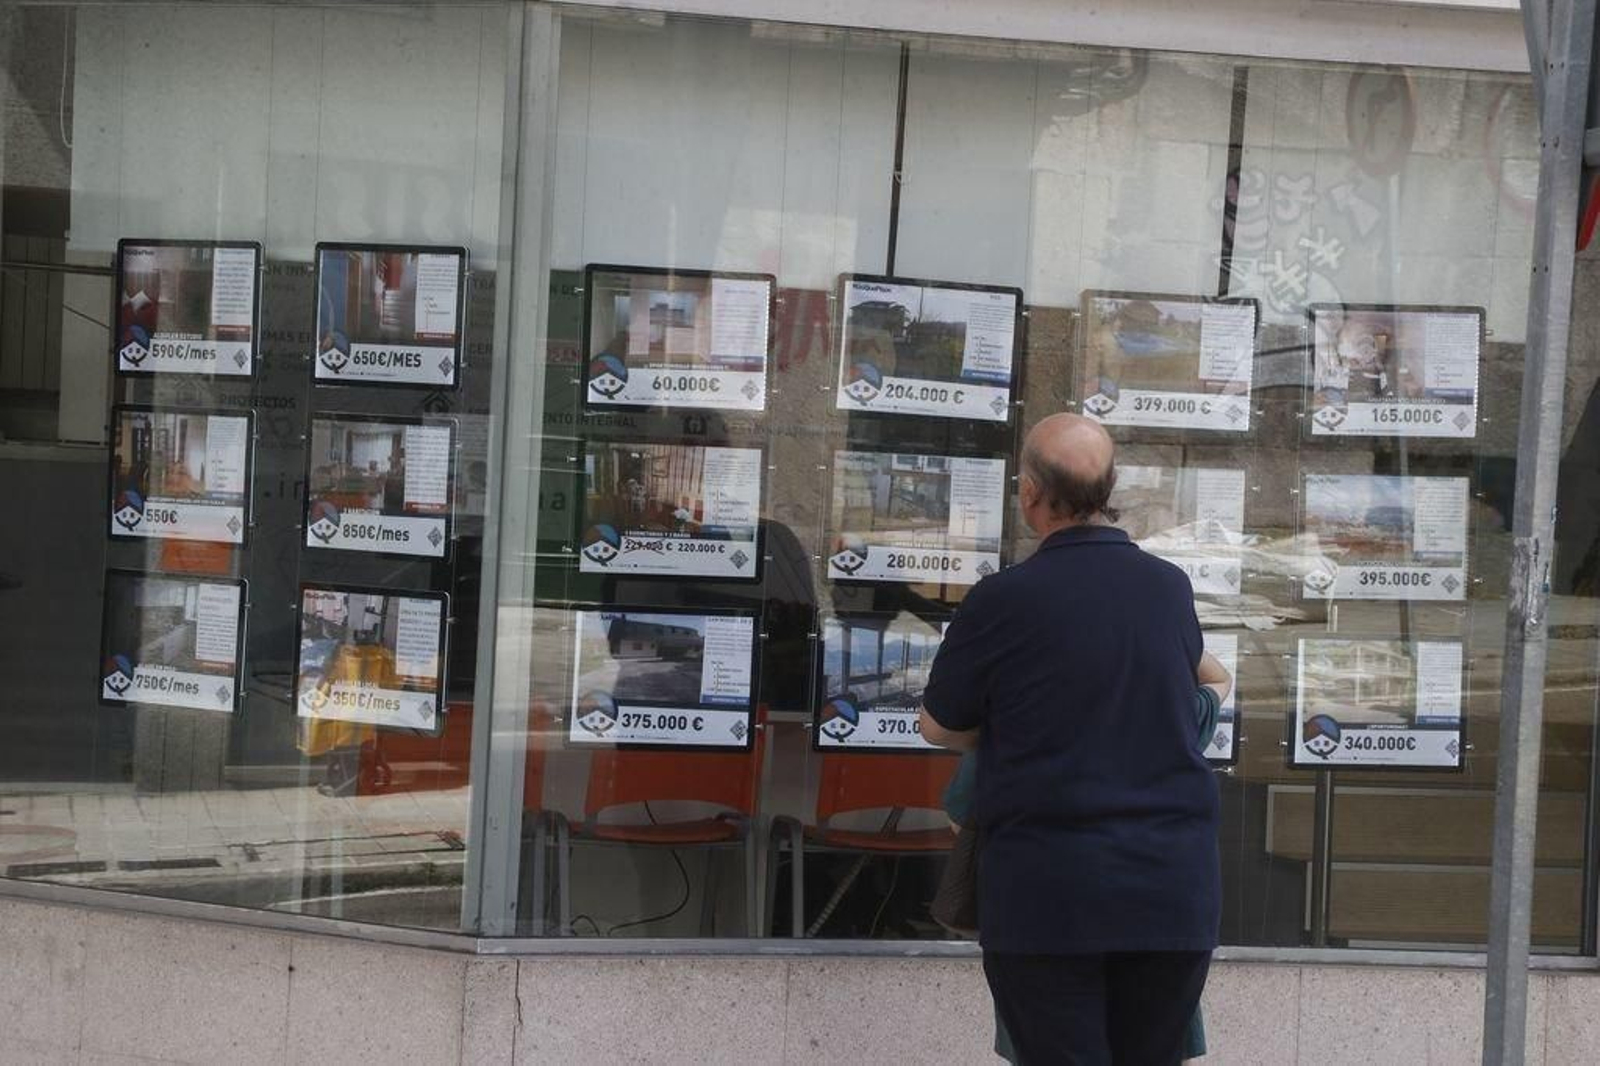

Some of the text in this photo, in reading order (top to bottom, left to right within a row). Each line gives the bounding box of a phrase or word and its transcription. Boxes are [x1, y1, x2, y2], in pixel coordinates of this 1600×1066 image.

[152, 343, 216, 361] 590€/mes
[353, 350, 421, 367] 650€/MES
[652, 376, 720, 392] 60.000€
[885, 384, 965, 404] 204.000 €
[1134, 397, 1212, 415] 379.000 €
[1372, 408, 1443, 424] 165.000€
[146, 508, 178, 525] 550€
[342, 524, 410, 541] 850€/mes
[665, 541, 673, 551] €
[677, 541, 716, 553] 220.000
[718, 543, 726, 553] €
[887, 554, 962, 571] 280.000€
[1359, 571, 1432, 586] 395.000€
[135, 674, 200, 694] 750€/mes
[332, 689, 401, 711] 350€/mes
[621, 713, 704, 731] 375.000 €
[877, 719, 920, 734] 370.0
[1344, 736, 1417, 751] 340.000€
